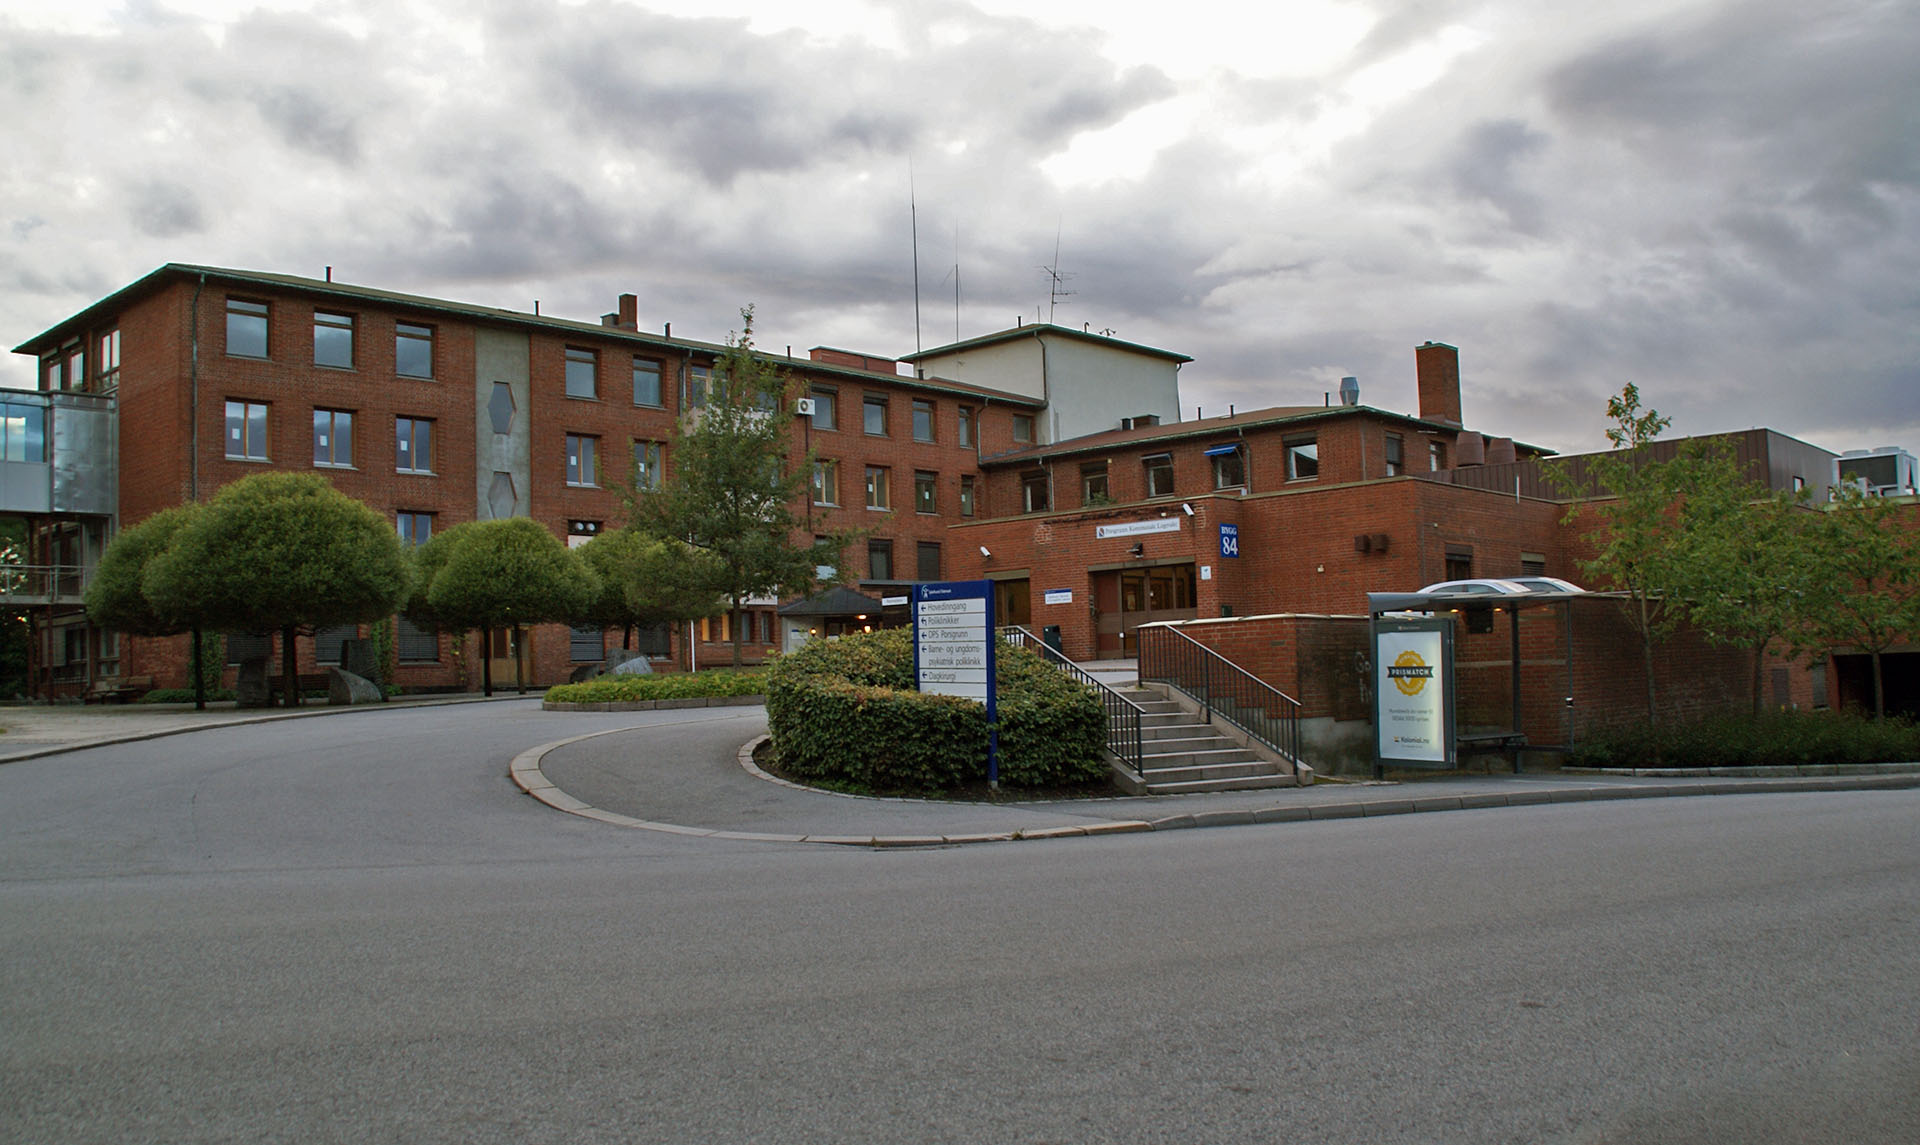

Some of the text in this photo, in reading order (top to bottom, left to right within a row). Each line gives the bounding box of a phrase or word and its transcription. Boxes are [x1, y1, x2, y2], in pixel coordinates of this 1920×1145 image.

[1221, 526, 1237, 535] BYGG
[1222, 536, 1238, 555] 84
[928, 602, 967, 612] Hovedinngang
[928, 616, 960, 625] Poliklinikker
[928, 630, 968, 640] DPS Porsgrunn
[946, 646, 954, 655] og
[928, 671, 956, 682] Dagkirurgi
[1391, 668, 1430, 676] PRISMATCH
